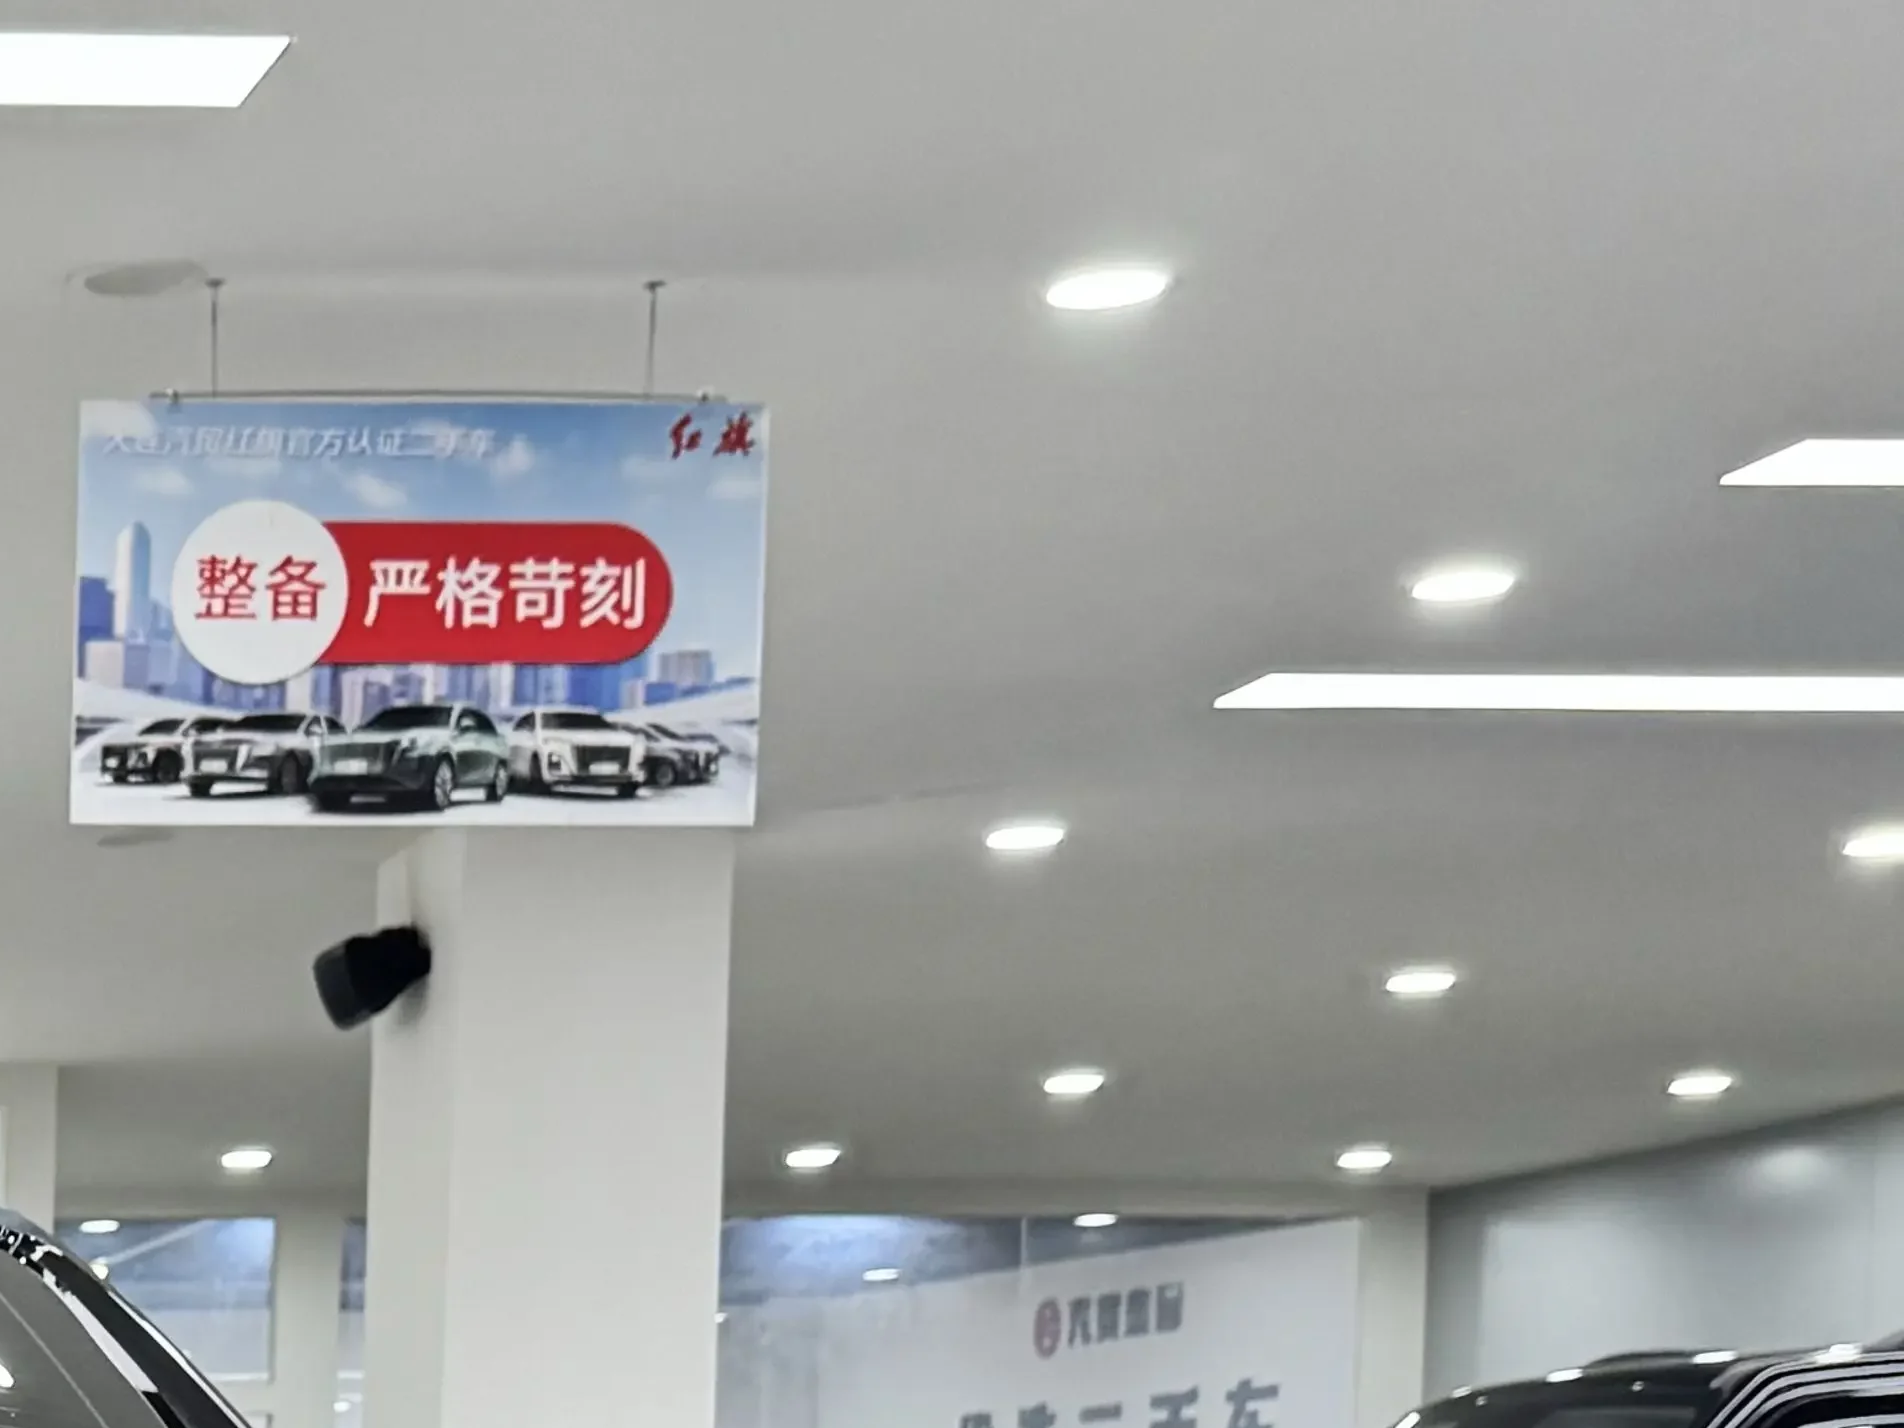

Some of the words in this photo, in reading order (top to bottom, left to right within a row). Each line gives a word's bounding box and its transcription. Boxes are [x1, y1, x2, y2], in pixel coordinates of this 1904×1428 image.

[667, 411, 756, 460] 红旗
[193, 555, 328, 623] 整备
[363, 557, 648, 631] 严格苛刻
